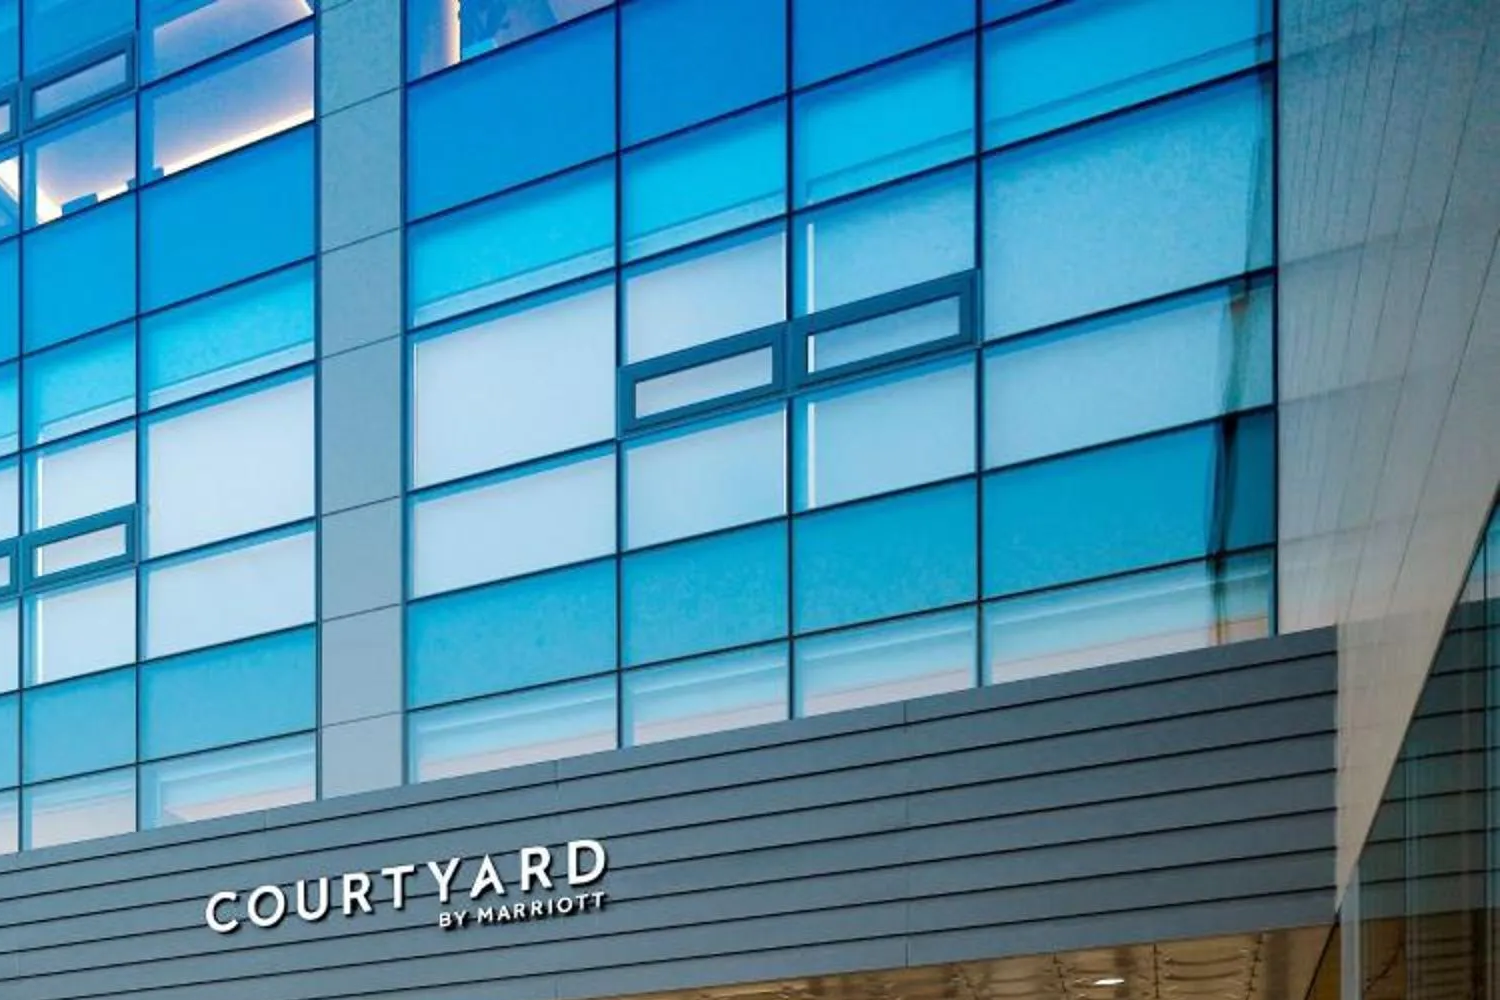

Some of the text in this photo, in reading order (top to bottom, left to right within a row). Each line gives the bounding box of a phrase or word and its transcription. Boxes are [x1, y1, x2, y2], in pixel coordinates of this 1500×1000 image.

[205, 839, 606, 934] COURTYARD
[439, 891, 605, 928] BY MARRIOTT
